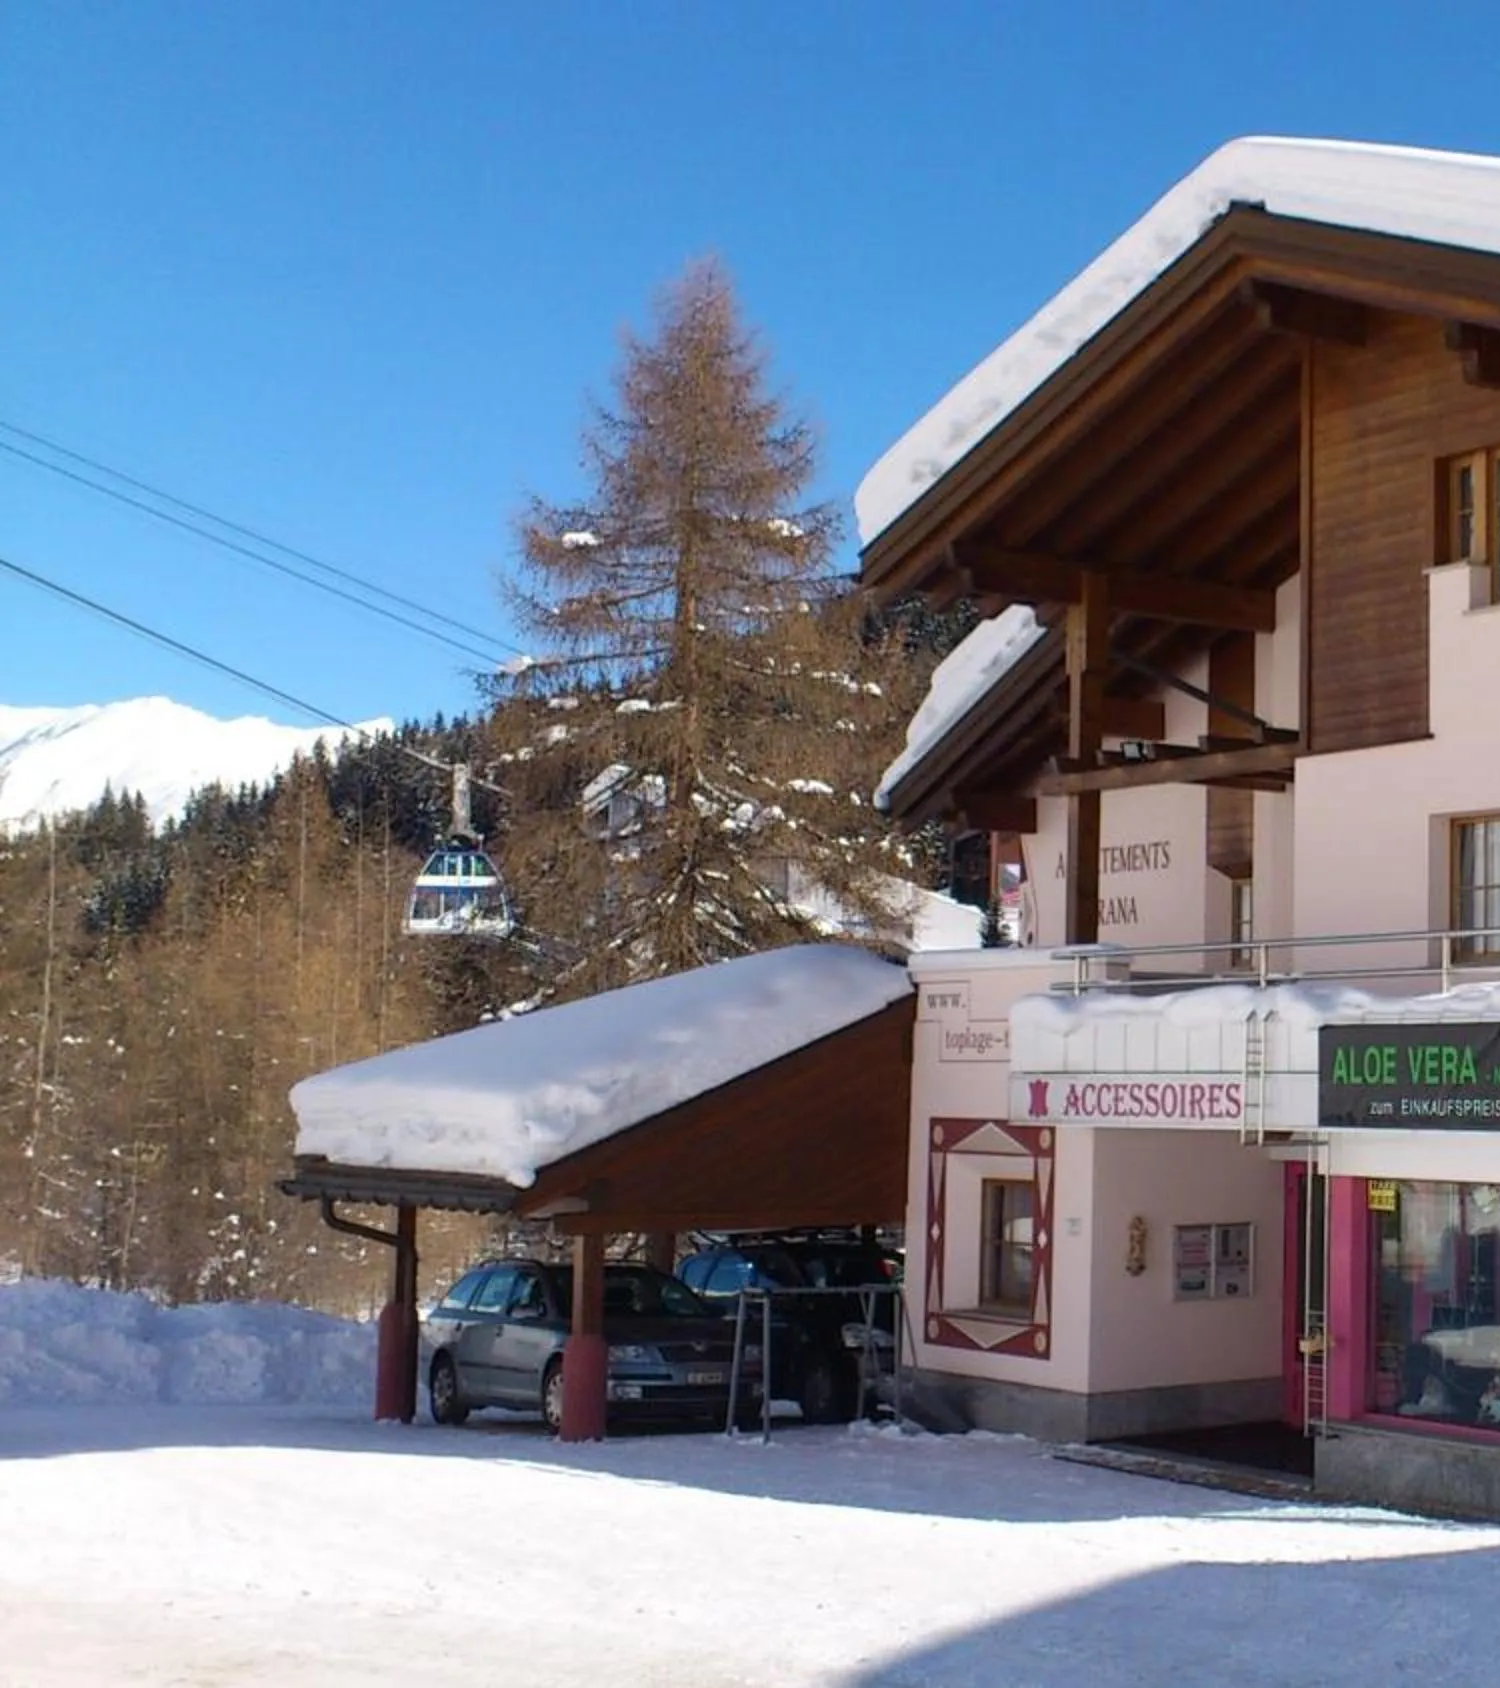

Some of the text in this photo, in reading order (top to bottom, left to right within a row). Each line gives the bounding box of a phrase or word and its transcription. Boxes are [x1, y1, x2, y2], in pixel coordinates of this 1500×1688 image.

[1333, 1044, 1398, 1086] ALOE
[1407, 1044, 1477, 1086] VERA
[1063, 1082, 1242, 1120] ACCESSOIRES
